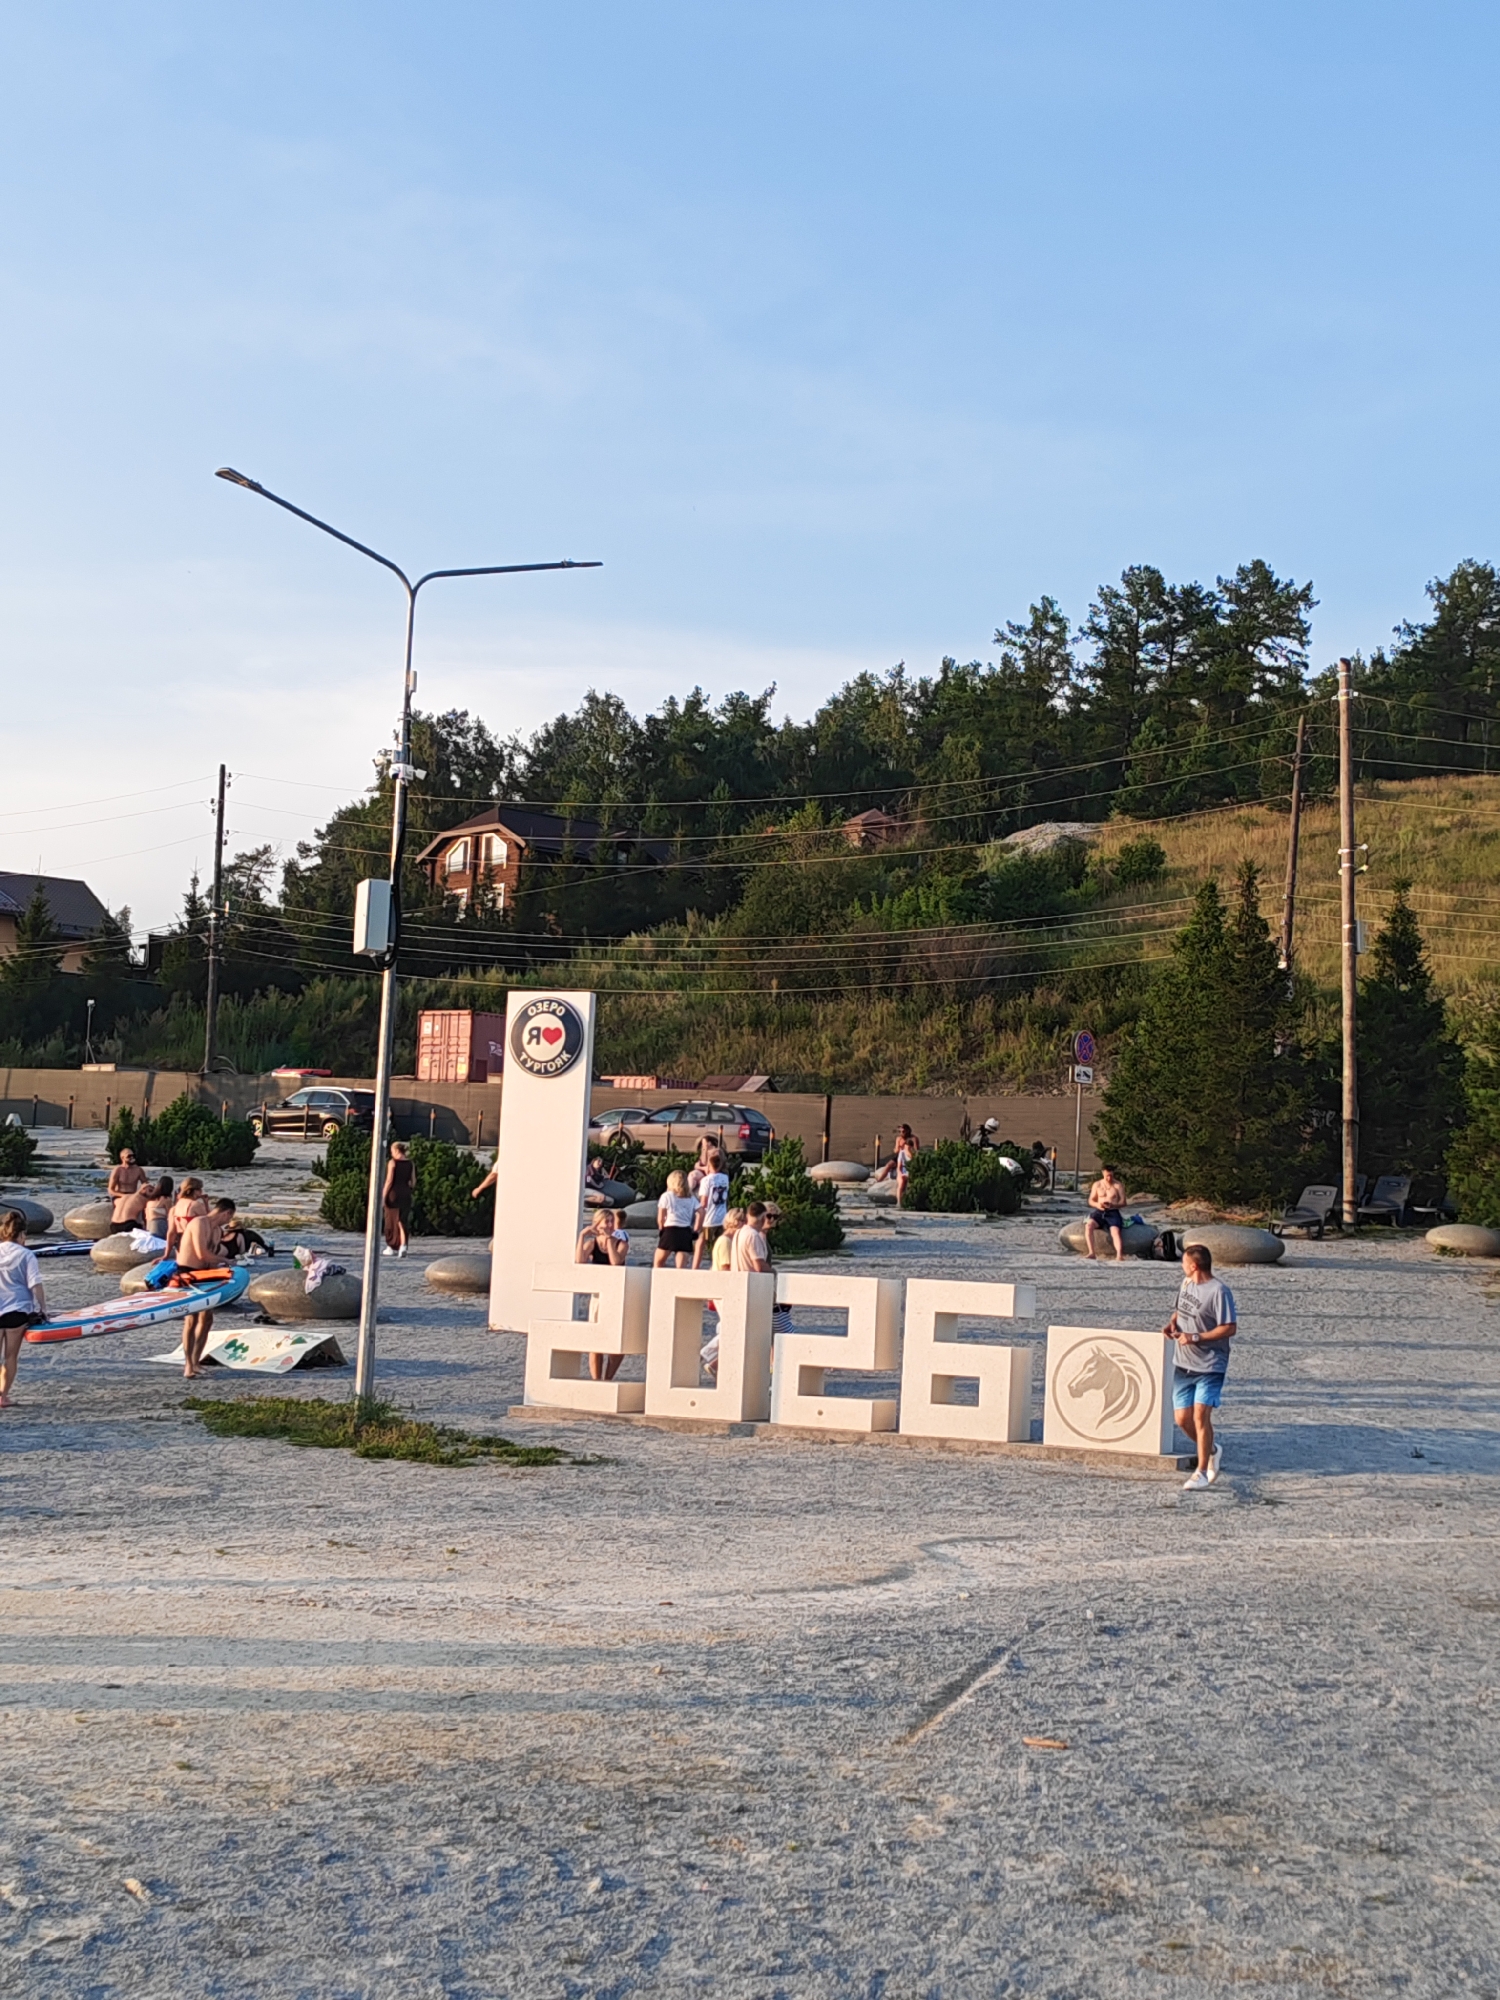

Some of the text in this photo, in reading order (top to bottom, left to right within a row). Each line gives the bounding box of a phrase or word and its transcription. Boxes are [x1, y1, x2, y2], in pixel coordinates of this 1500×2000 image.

[528, 1002, 565, 1016] ОЗЕРО
[527, 1027, 541, 1045] Я
[520, 1051, 571, 1073] ТУРГОЯК
[523, 1262, 1034, 1443] 2026
